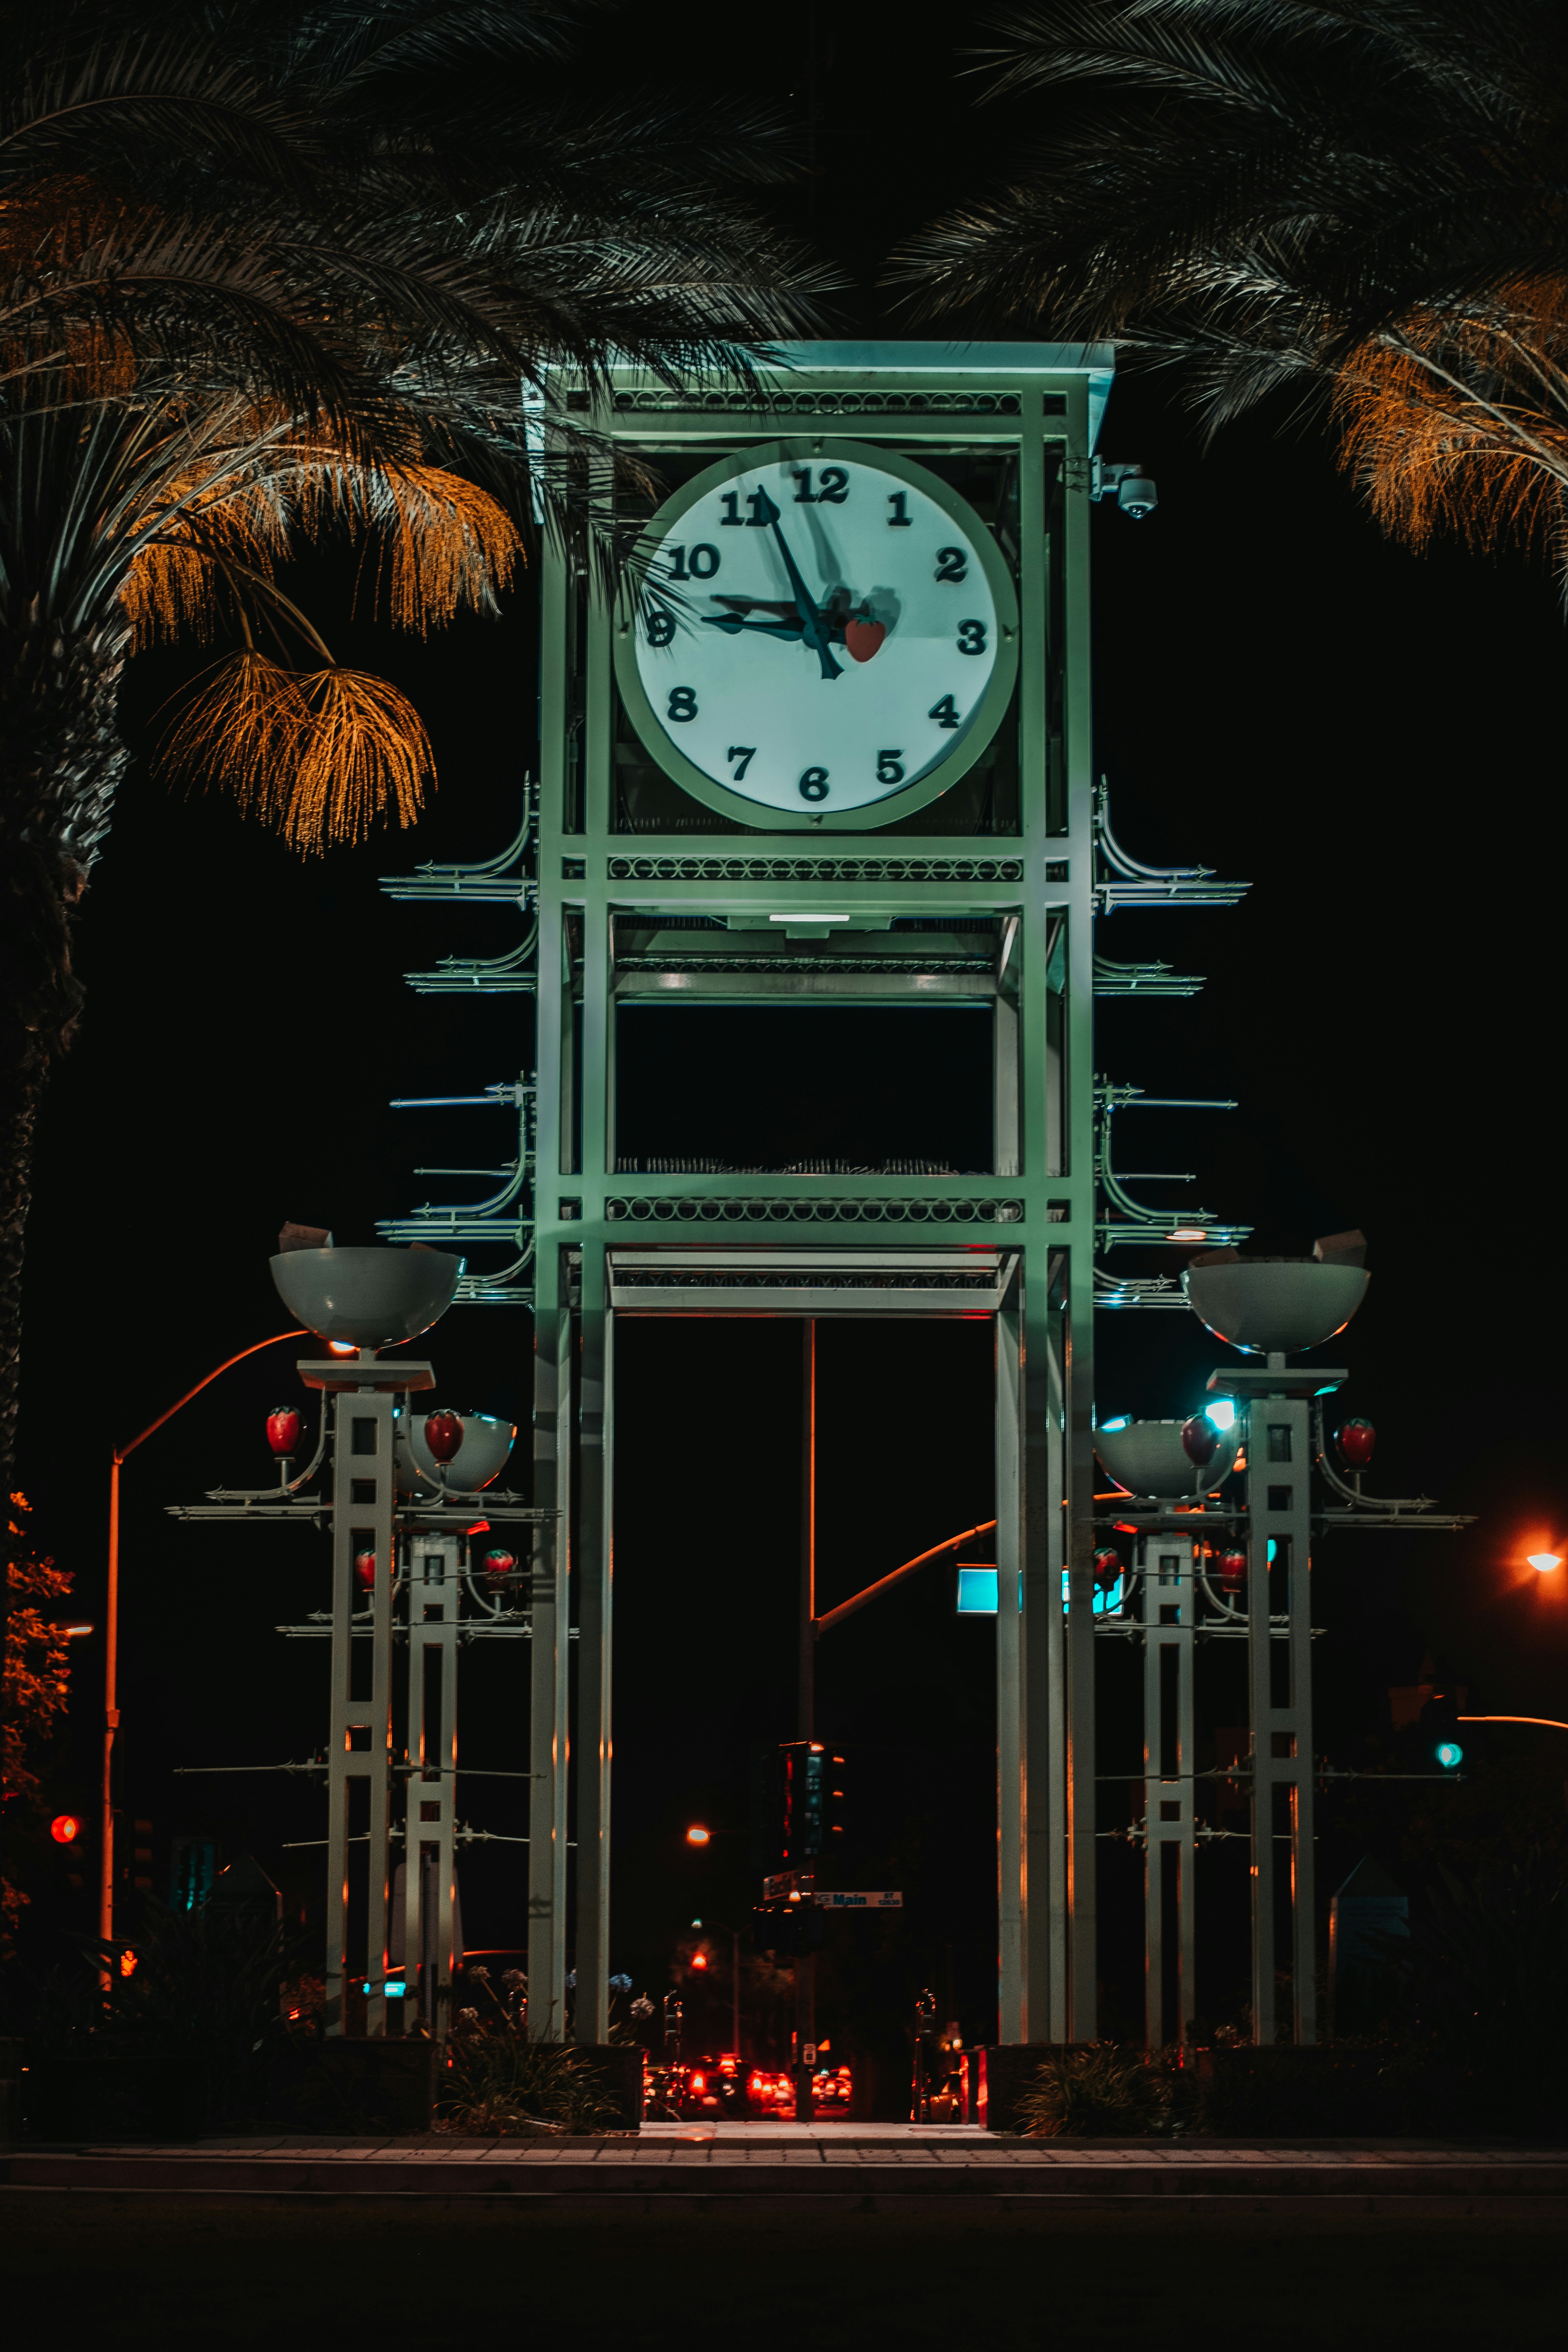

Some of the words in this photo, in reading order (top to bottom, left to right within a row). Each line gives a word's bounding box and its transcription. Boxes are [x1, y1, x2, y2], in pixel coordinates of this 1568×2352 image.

[794, 467, 849, 504] 12
[720, 490, 768, 527] 11
[888, 491, 912, 526] 1
[668, 543, 721, 581] 10
[935, 547, 967, 583] 2
[647, 611, 676, 648] 9
[957, 619, 986, 655] 3
[668, 686, 698, 722] 8
[929, 695, 960, 728] 4
[728, 746, 757, 781] 7
[876, 750, 904, 784] 5
[799, 767, 829, 802] 6
[833, 1894, 867, 1905] Main
